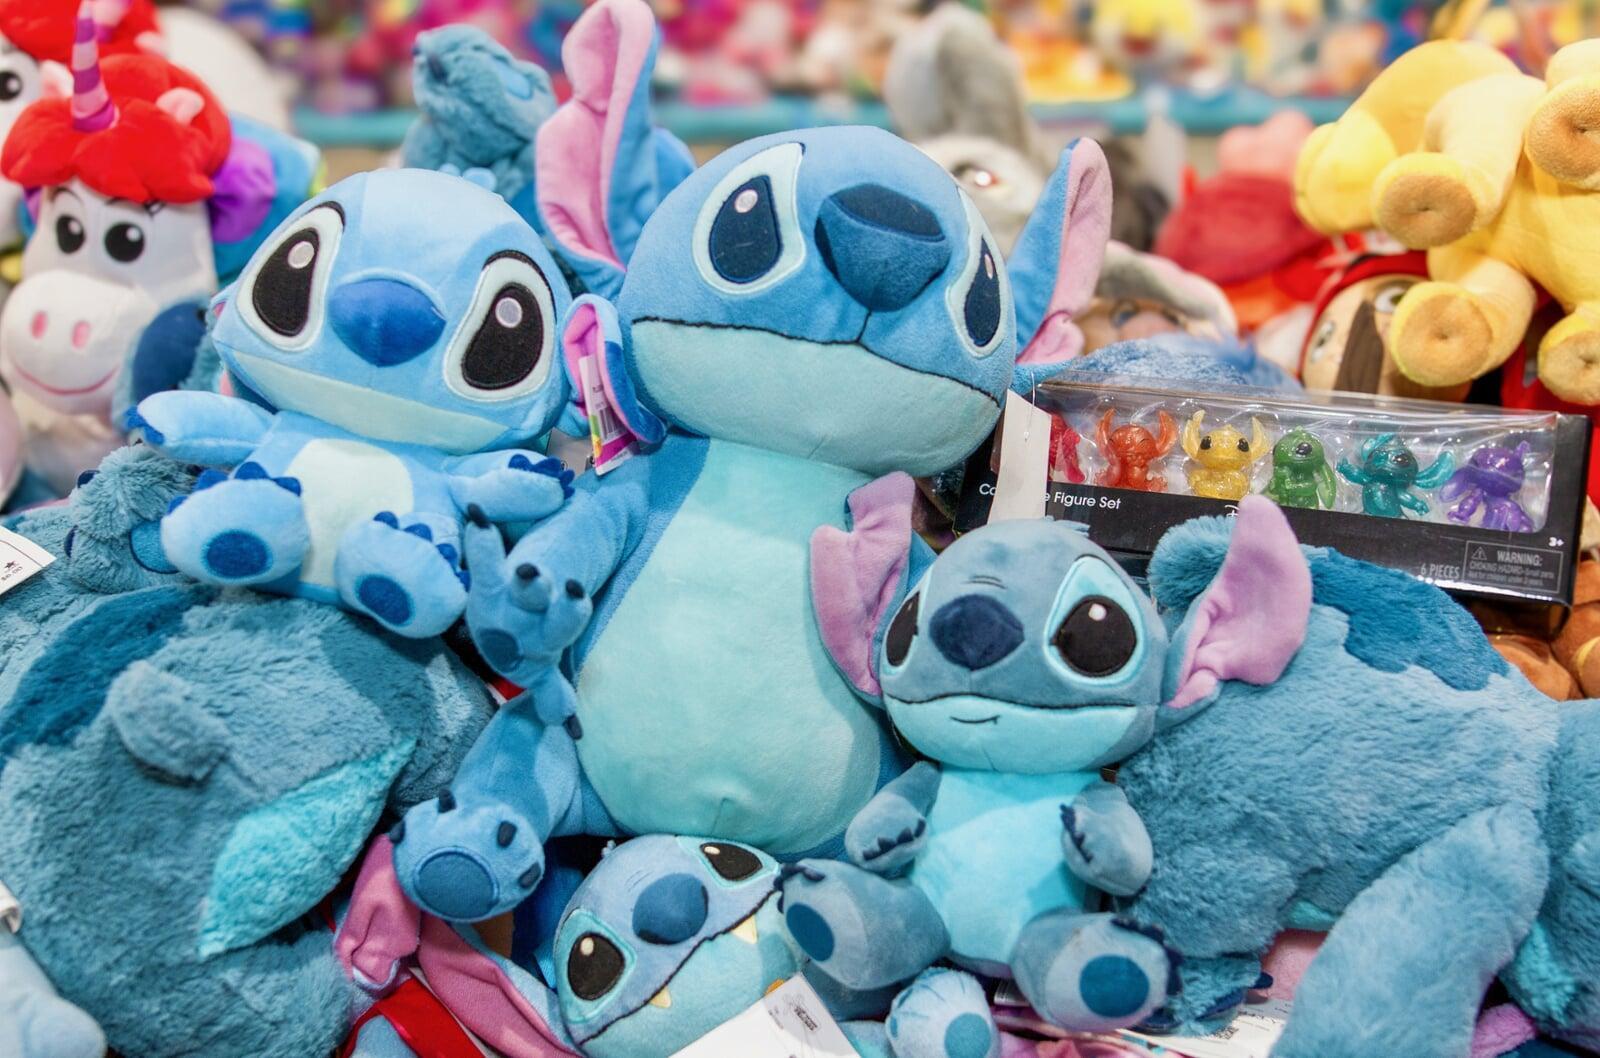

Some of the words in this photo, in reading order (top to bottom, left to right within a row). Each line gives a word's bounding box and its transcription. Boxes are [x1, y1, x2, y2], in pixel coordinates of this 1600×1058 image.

[1054, 491, 1096, 506] Figure
[1099, 496, 1121, 509] Set
[1549, 537, 1564, 547] 3+
[1497, 550, 1543, 566] WARNING:
[1420, 564, 1426, 576] 6
[1430, 564, 1460, 579] PIECES
